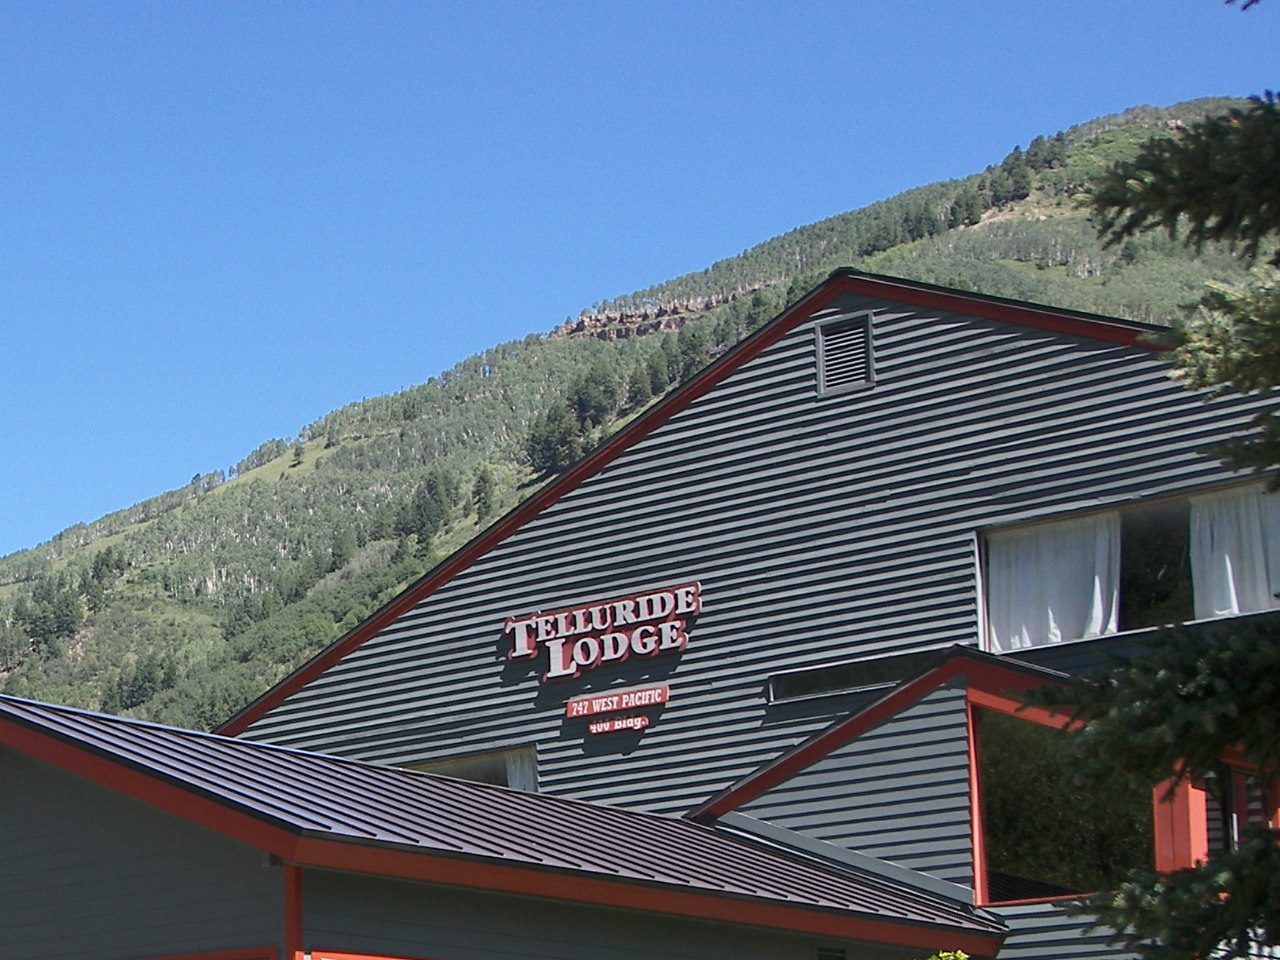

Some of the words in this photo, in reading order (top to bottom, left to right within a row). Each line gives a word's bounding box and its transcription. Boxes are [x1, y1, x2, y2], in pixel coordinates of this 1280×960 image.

[505, 586, 698, 657] TELLURIDE
[545, 620, 684, 678] LODGE
[572, 702, 588, 715] 747
[592, 695, 618, 712] WEST
[622, 689, 662, 707] PACIFIC
